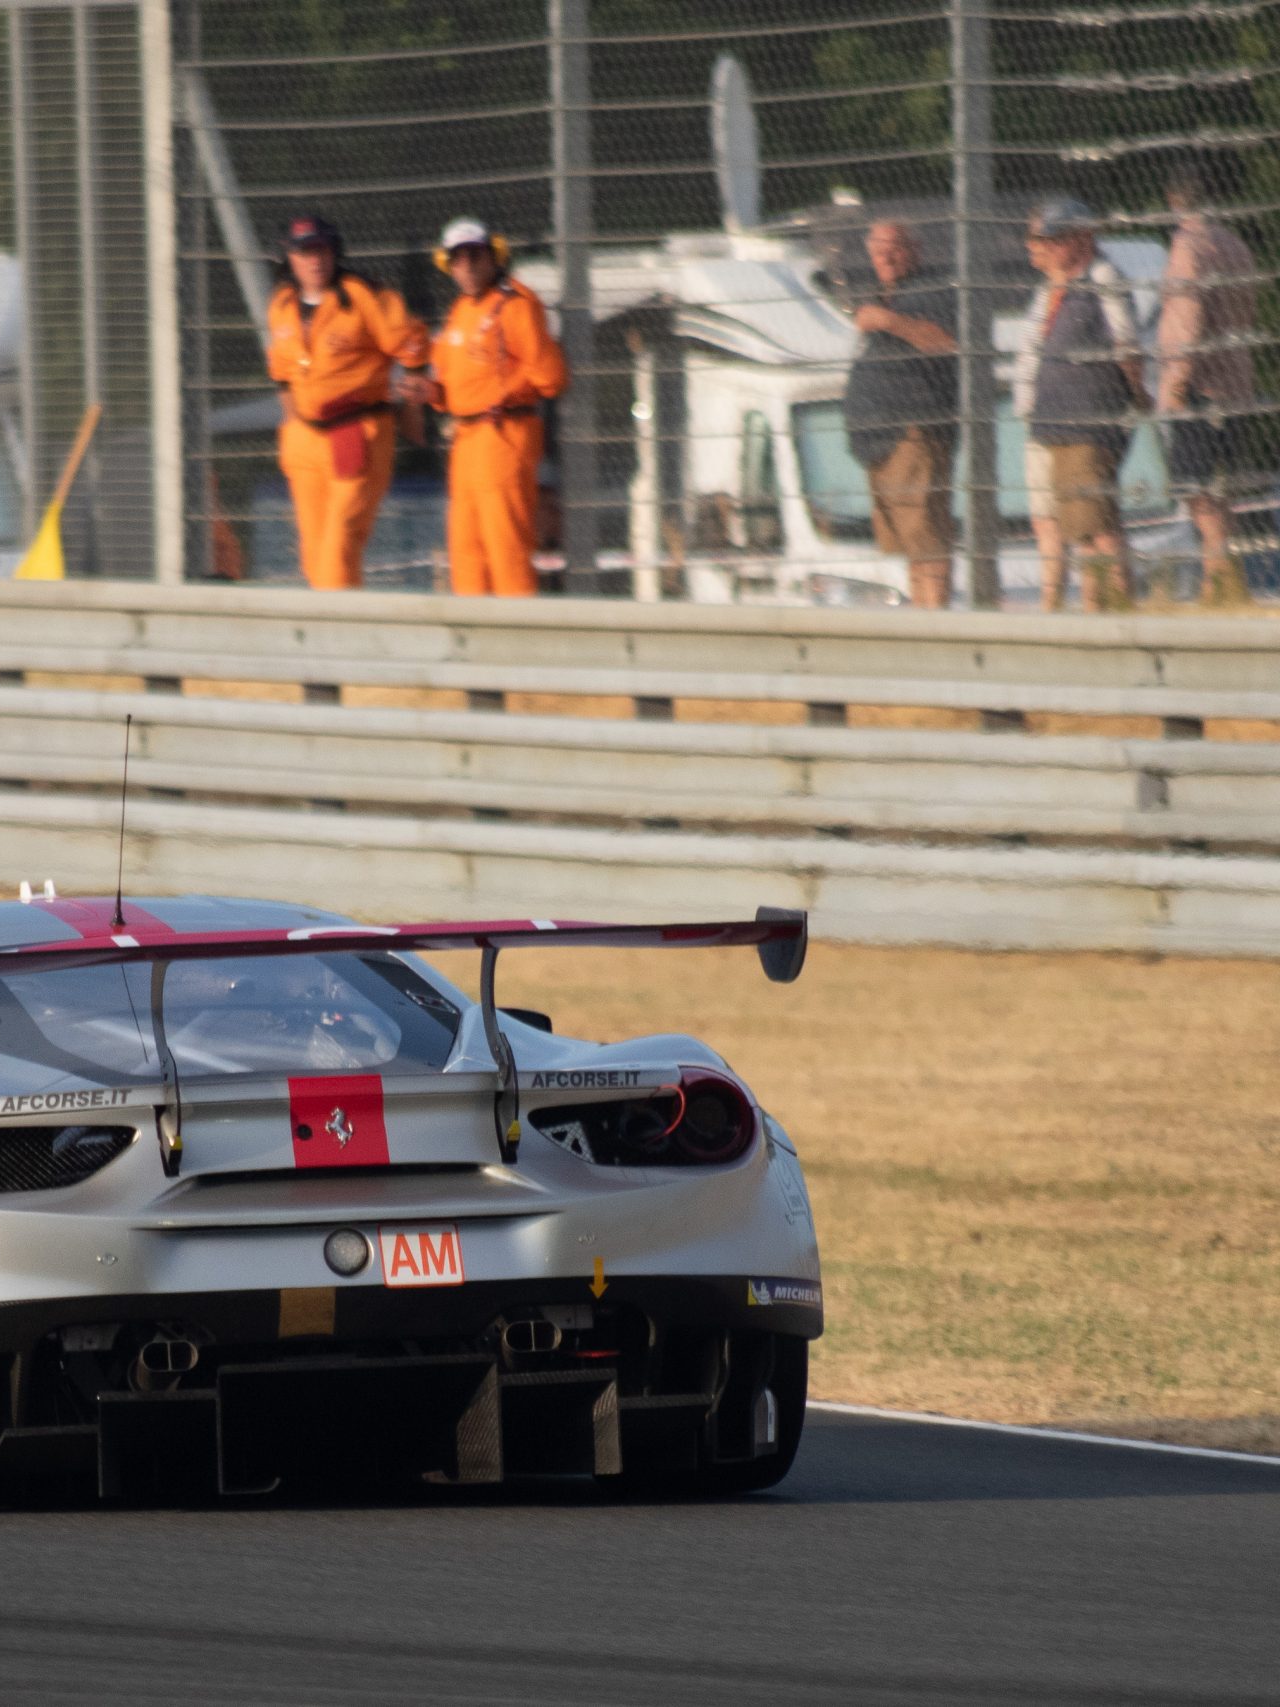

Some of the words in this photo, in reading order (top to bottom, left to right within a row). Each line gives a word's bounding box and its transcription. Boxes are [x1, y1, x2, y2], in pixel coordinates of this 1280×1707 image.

[531, 1070, 641, 1089] AFCORSE.IT
[1, 1088, 133, 1112] AFCORSE.IT
[390, 1232, 458, 1277] AM
